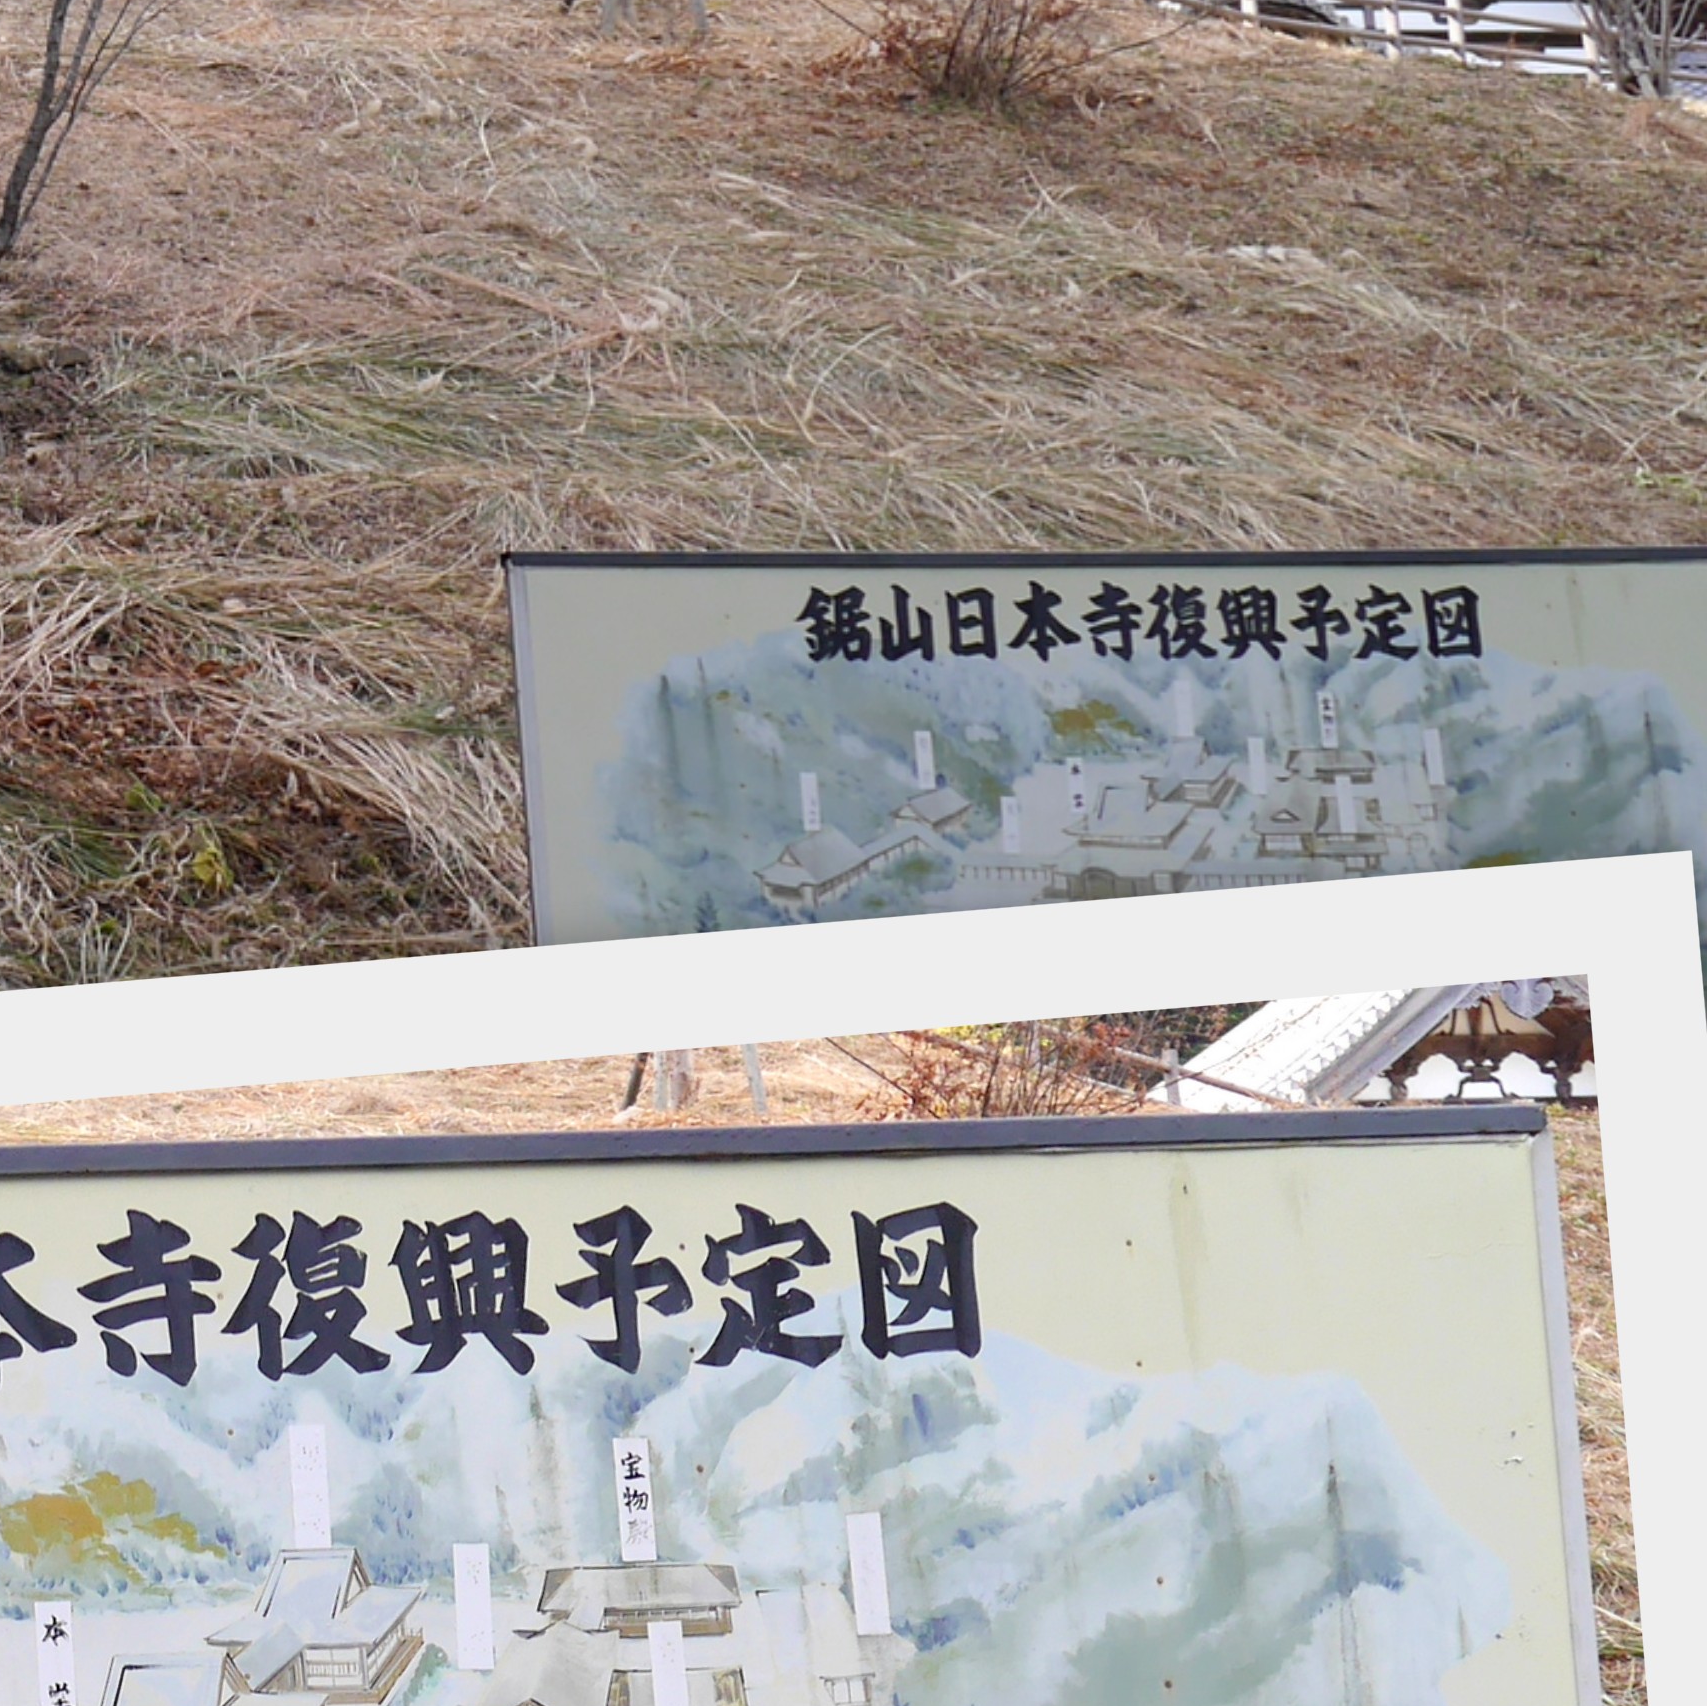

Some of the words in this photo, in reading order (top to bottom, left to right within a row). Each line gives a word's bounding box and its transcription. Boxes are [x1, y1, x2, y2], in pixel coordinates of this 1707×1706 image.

[797, 580, 1482, 663] 鋸山日本寺復興予定図
